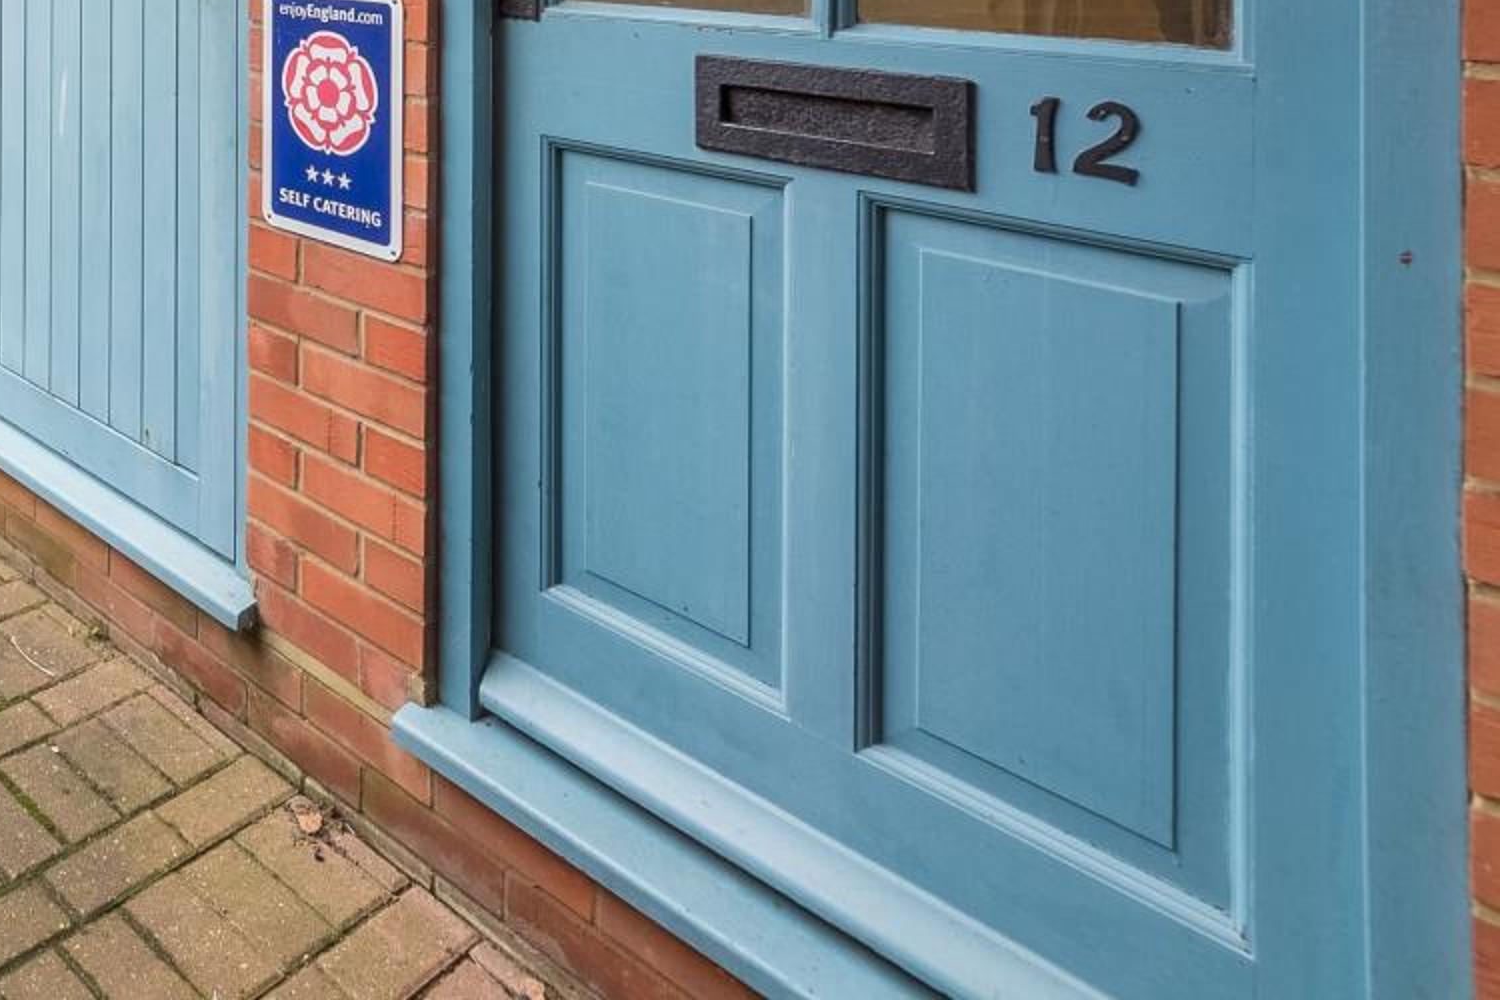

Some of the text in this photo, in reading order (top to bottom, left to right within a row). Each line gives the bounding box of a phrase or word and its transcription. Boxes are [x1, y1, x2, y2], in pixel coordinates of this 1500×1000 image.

[279, 2, 383, 25] enjoyEngland.com
[1030, 97, 1141, 186] 12
[279, 187, 381, 227] SELF CATERING
